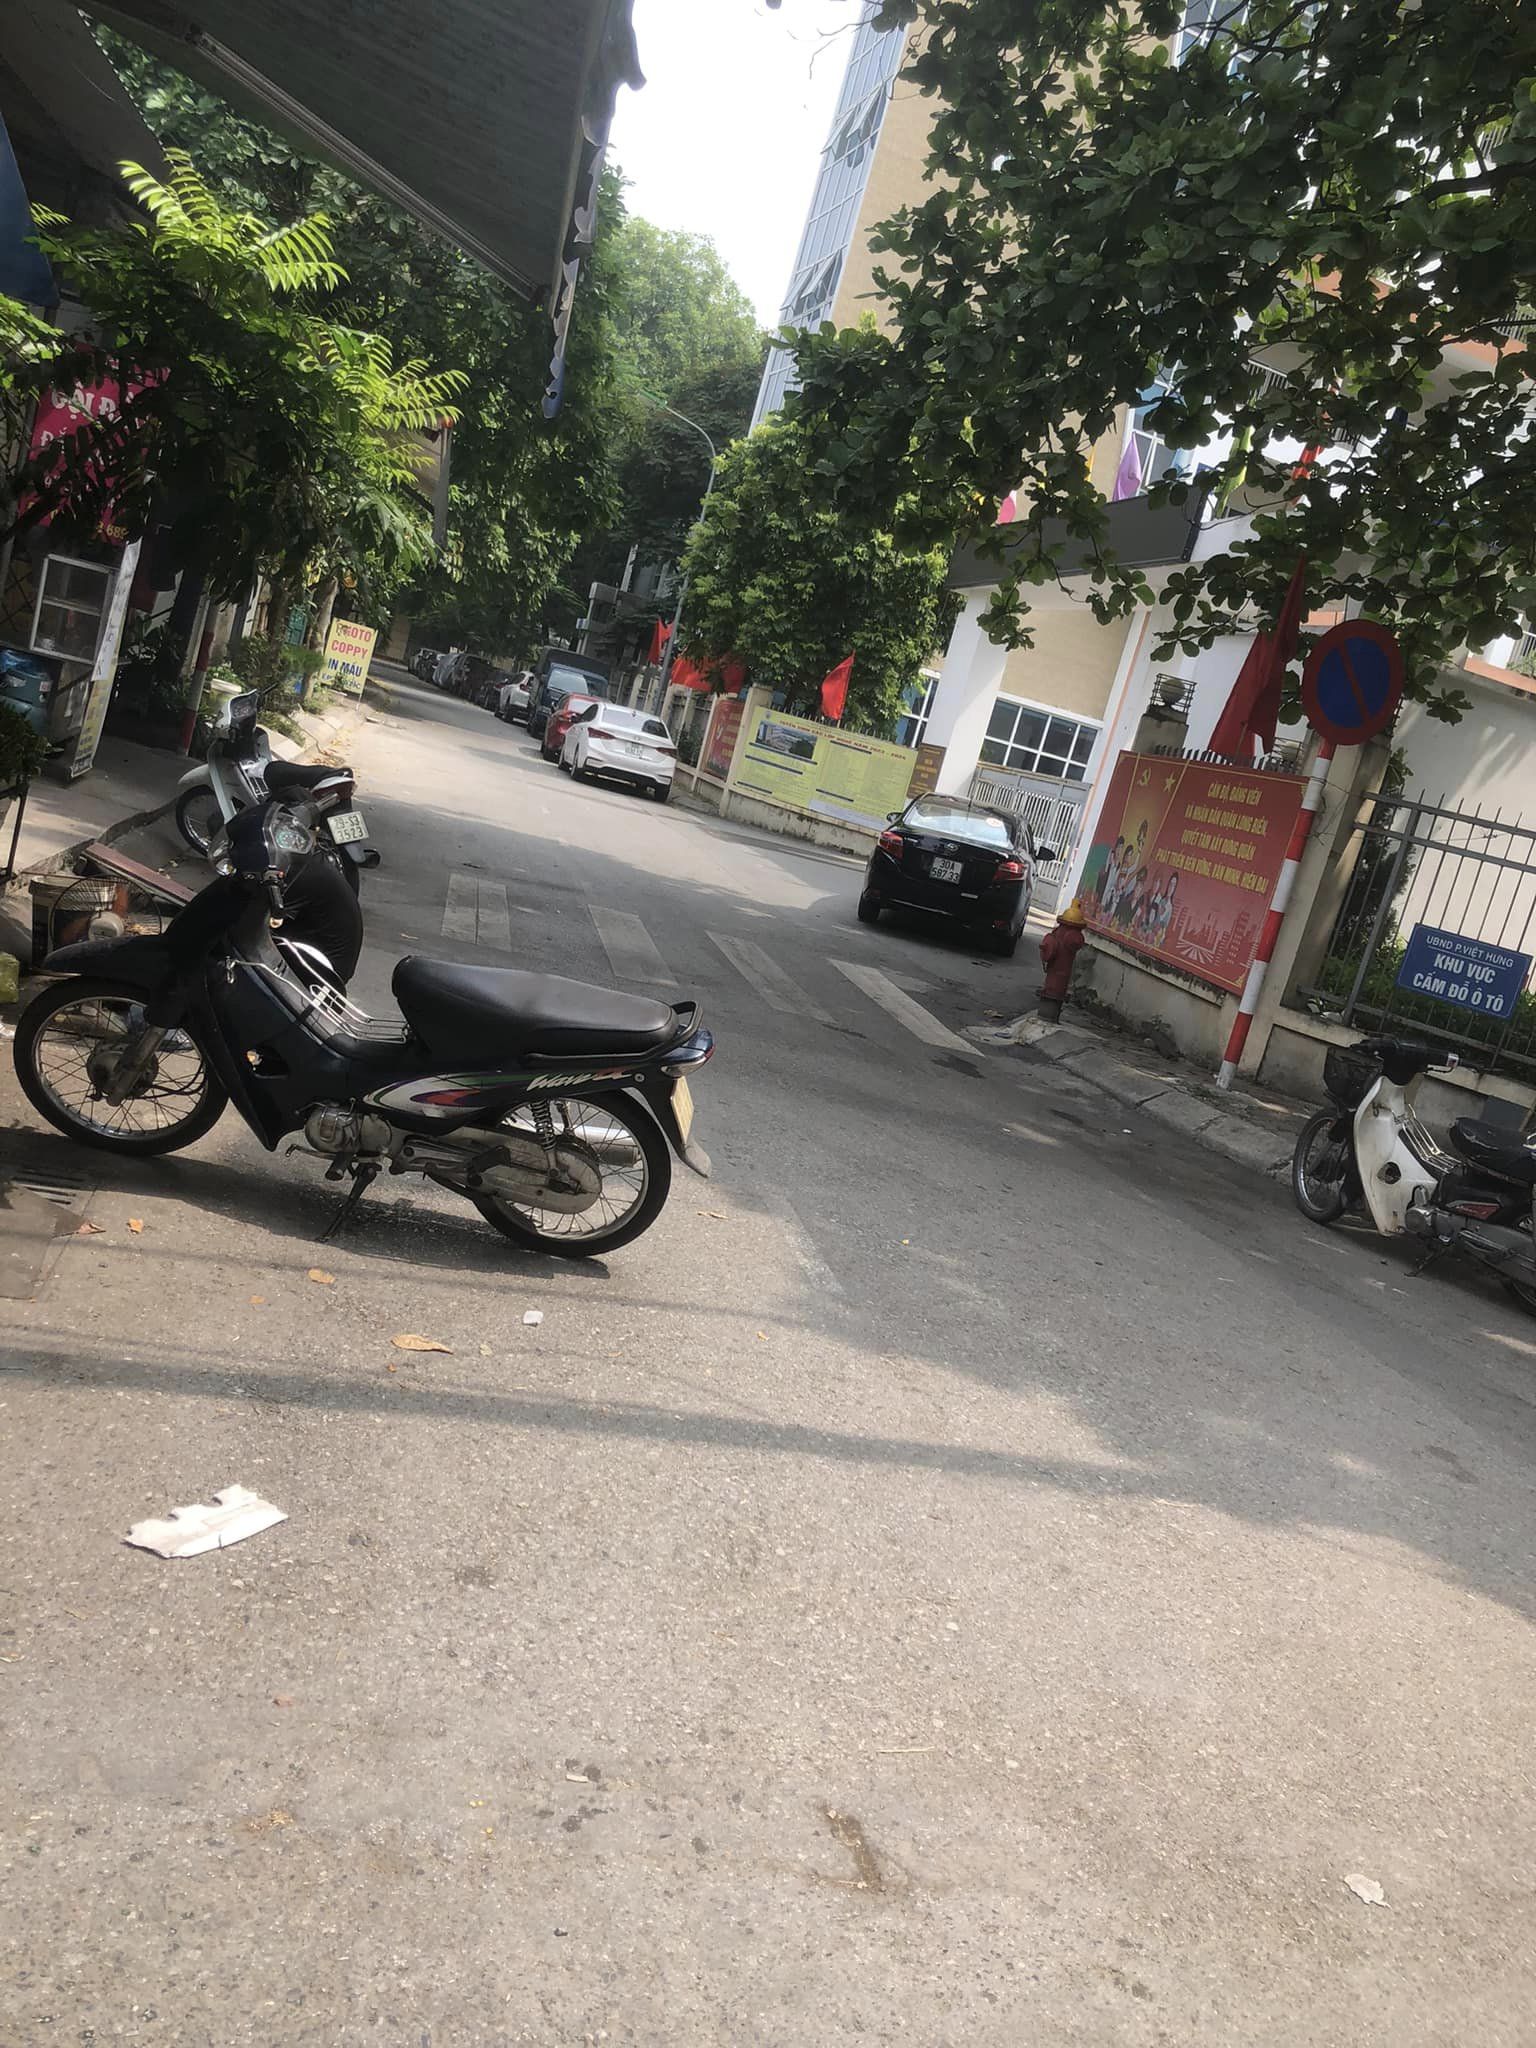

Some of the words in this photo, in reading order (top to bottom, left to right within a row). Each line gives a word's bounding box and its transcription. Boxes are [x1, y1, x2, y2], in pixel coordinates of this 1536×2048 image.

[331, 640, 368, 659] COPPY
[328, 658, 339, 670] IN
[939, 860, 955, 871] 30A
[1426, 935, 1453, 951] UBND
[1433, 953, 1464, 974] KHU
[1466, 963, 1496, 984] VỰC
[1412, 971, 1446, 995] CẤM
[1471, 987, 1483, 1005] Ô
[1485, 993, 1504, 1012] TÔ
